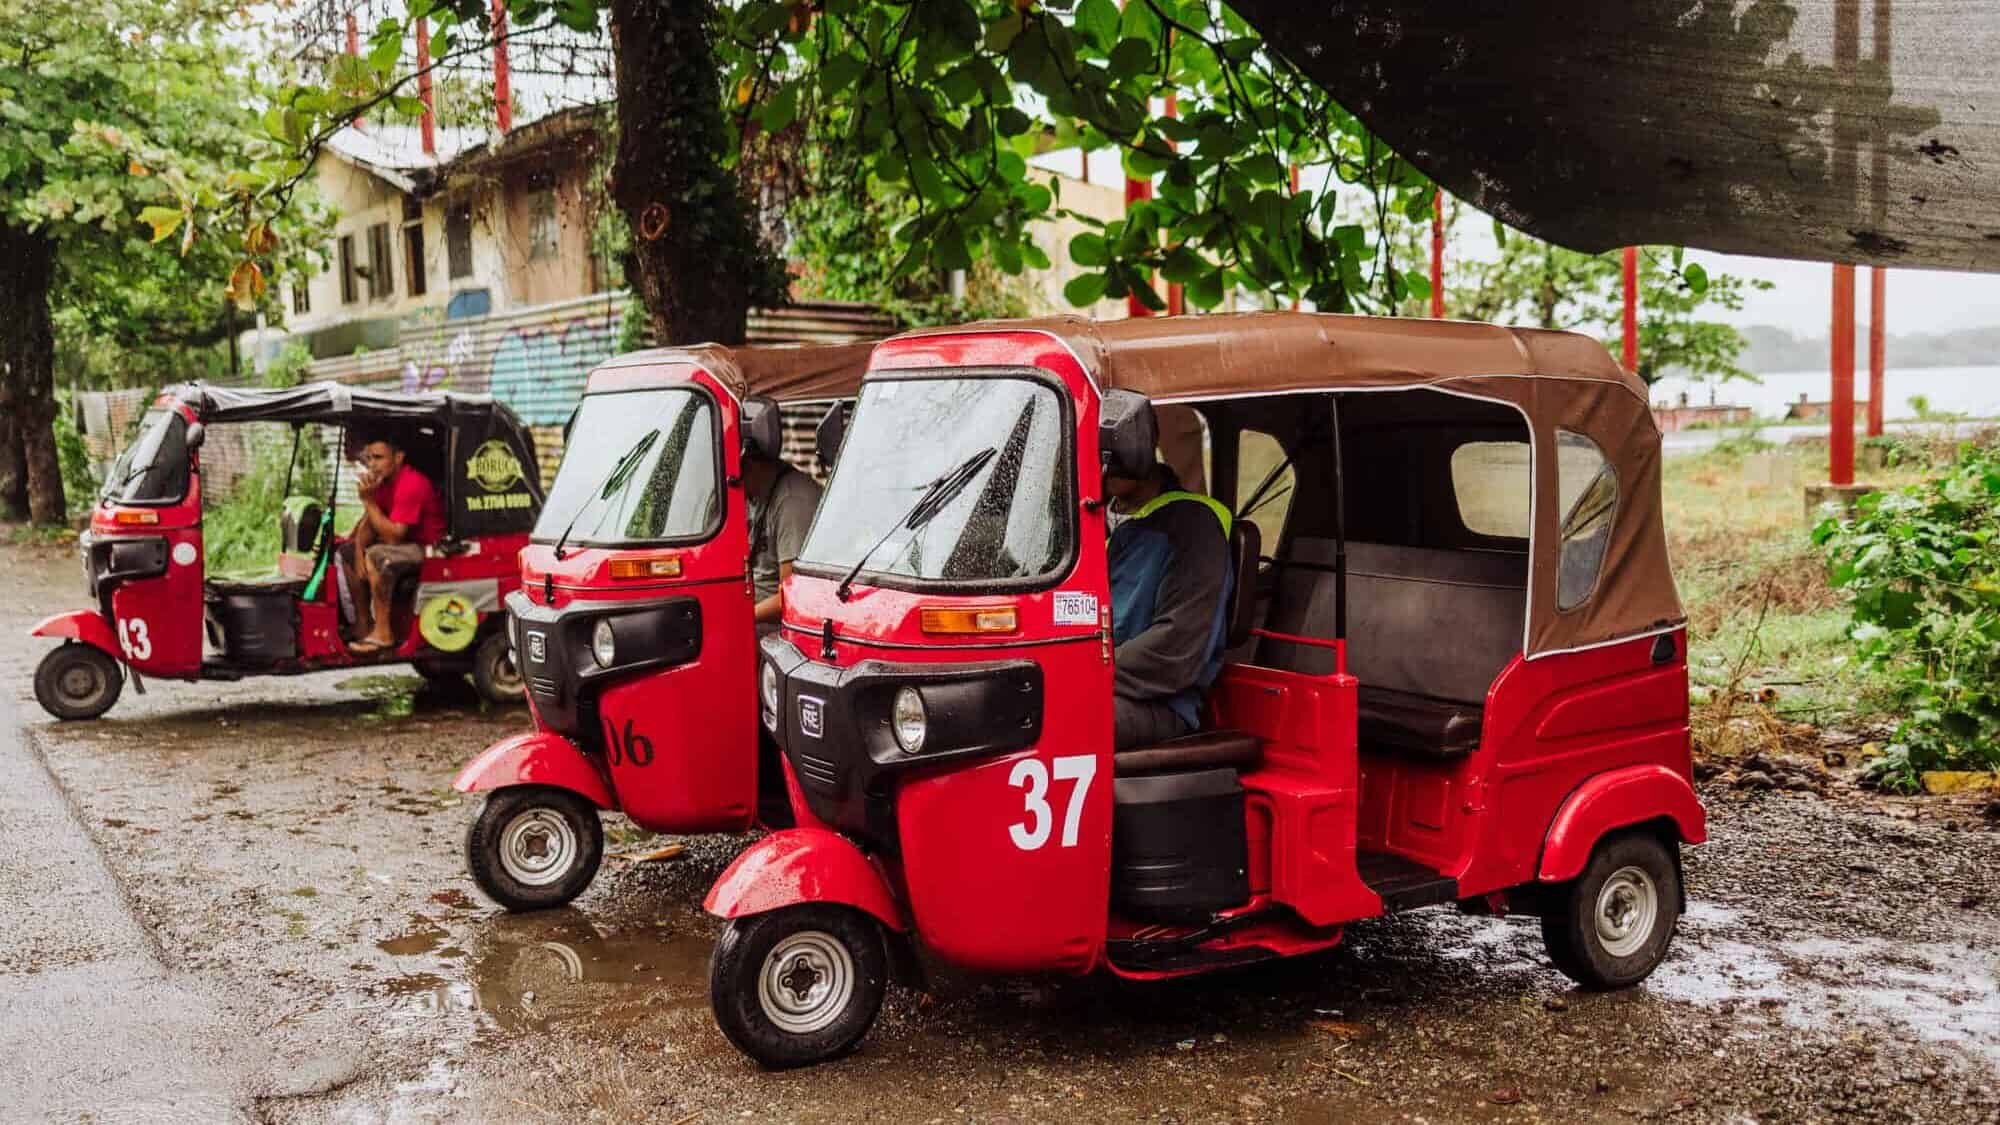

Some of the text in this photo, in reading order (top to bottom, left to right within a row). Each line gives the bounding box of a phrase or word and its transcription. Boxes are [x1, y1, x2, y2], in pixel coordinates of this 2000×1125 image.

[1063, 598, 1096, 615] 765104
[118, 618, 152, 660] 43
[802, 709, 819, 729] RE
[1008, 754, 1096, 850] 37
